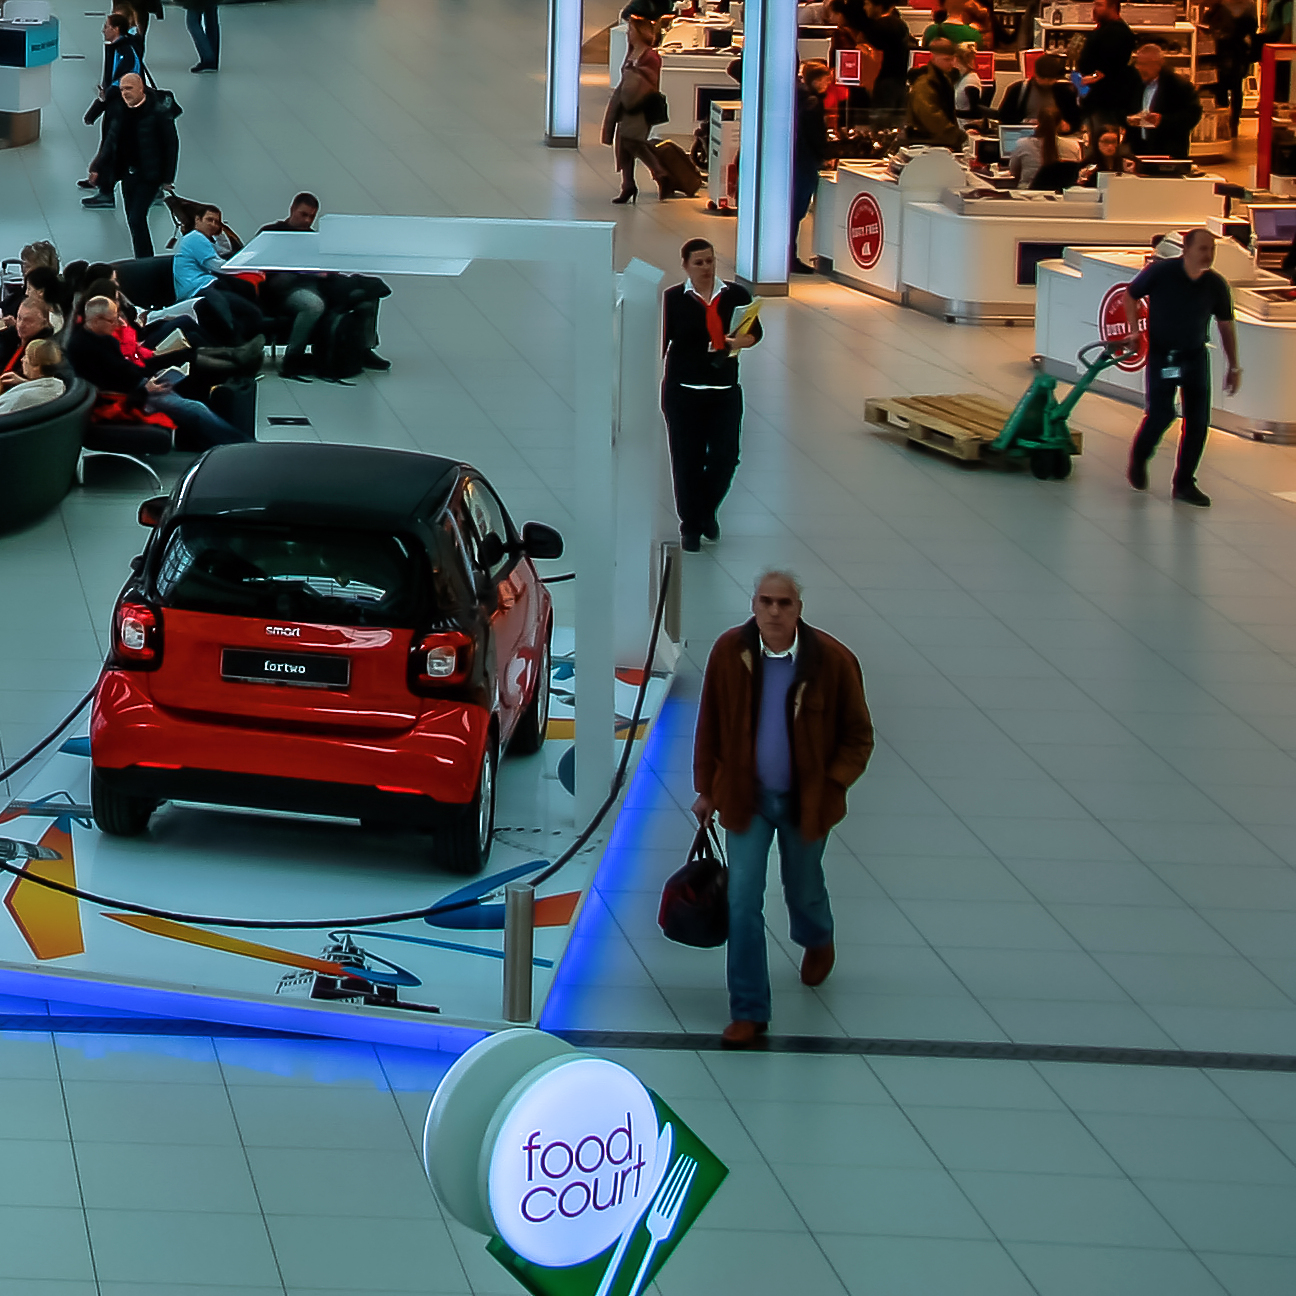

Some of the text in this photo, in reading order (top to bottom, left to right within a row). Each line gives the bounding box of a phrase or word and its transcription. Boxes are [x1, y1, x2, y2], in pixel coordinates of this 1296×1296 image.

[265, 626, 301, 637] smart
[264, 660, 306, 674] fortwo
[521, 1111, 633, 1182] food
[520, 1143, 646, 1223] court
